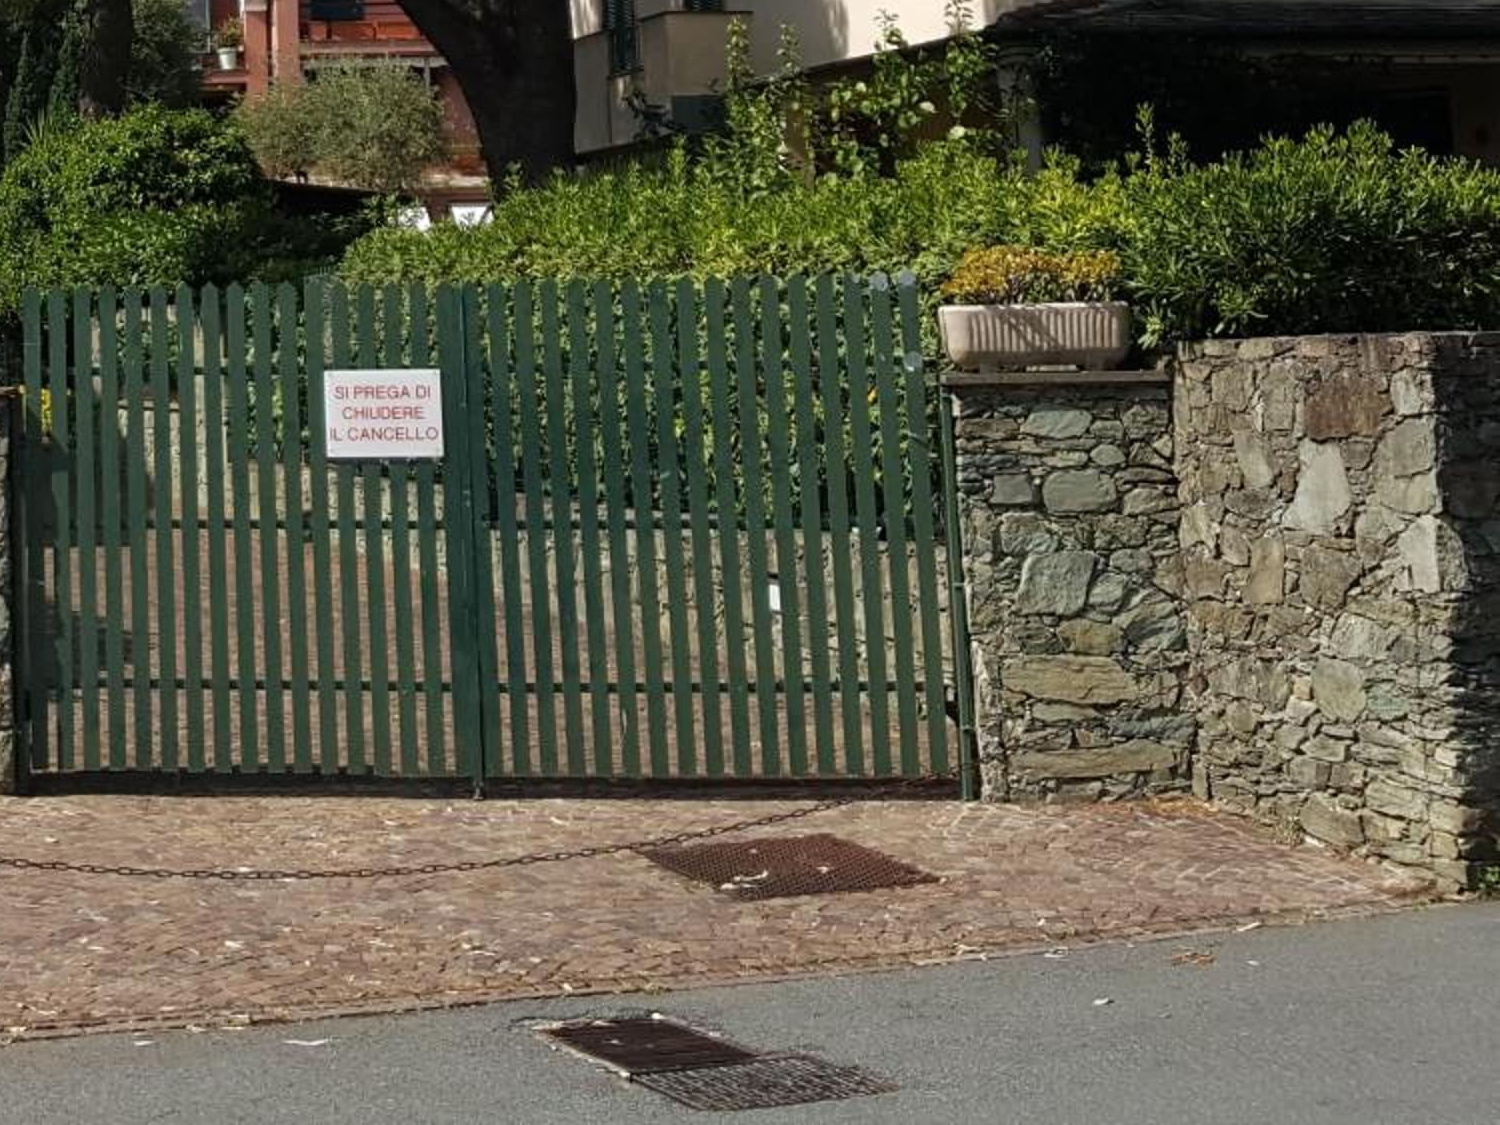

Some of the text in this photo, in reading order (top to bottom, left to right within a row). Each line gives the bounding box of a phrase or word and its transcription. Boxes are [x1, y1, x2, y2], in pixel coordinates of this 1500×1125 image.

[334, 385, 431, 400] SI PREGA DI
[341, 406, 426, 420] CHIUDERE
[329, 426, 439, 441] IL CANCELLO
